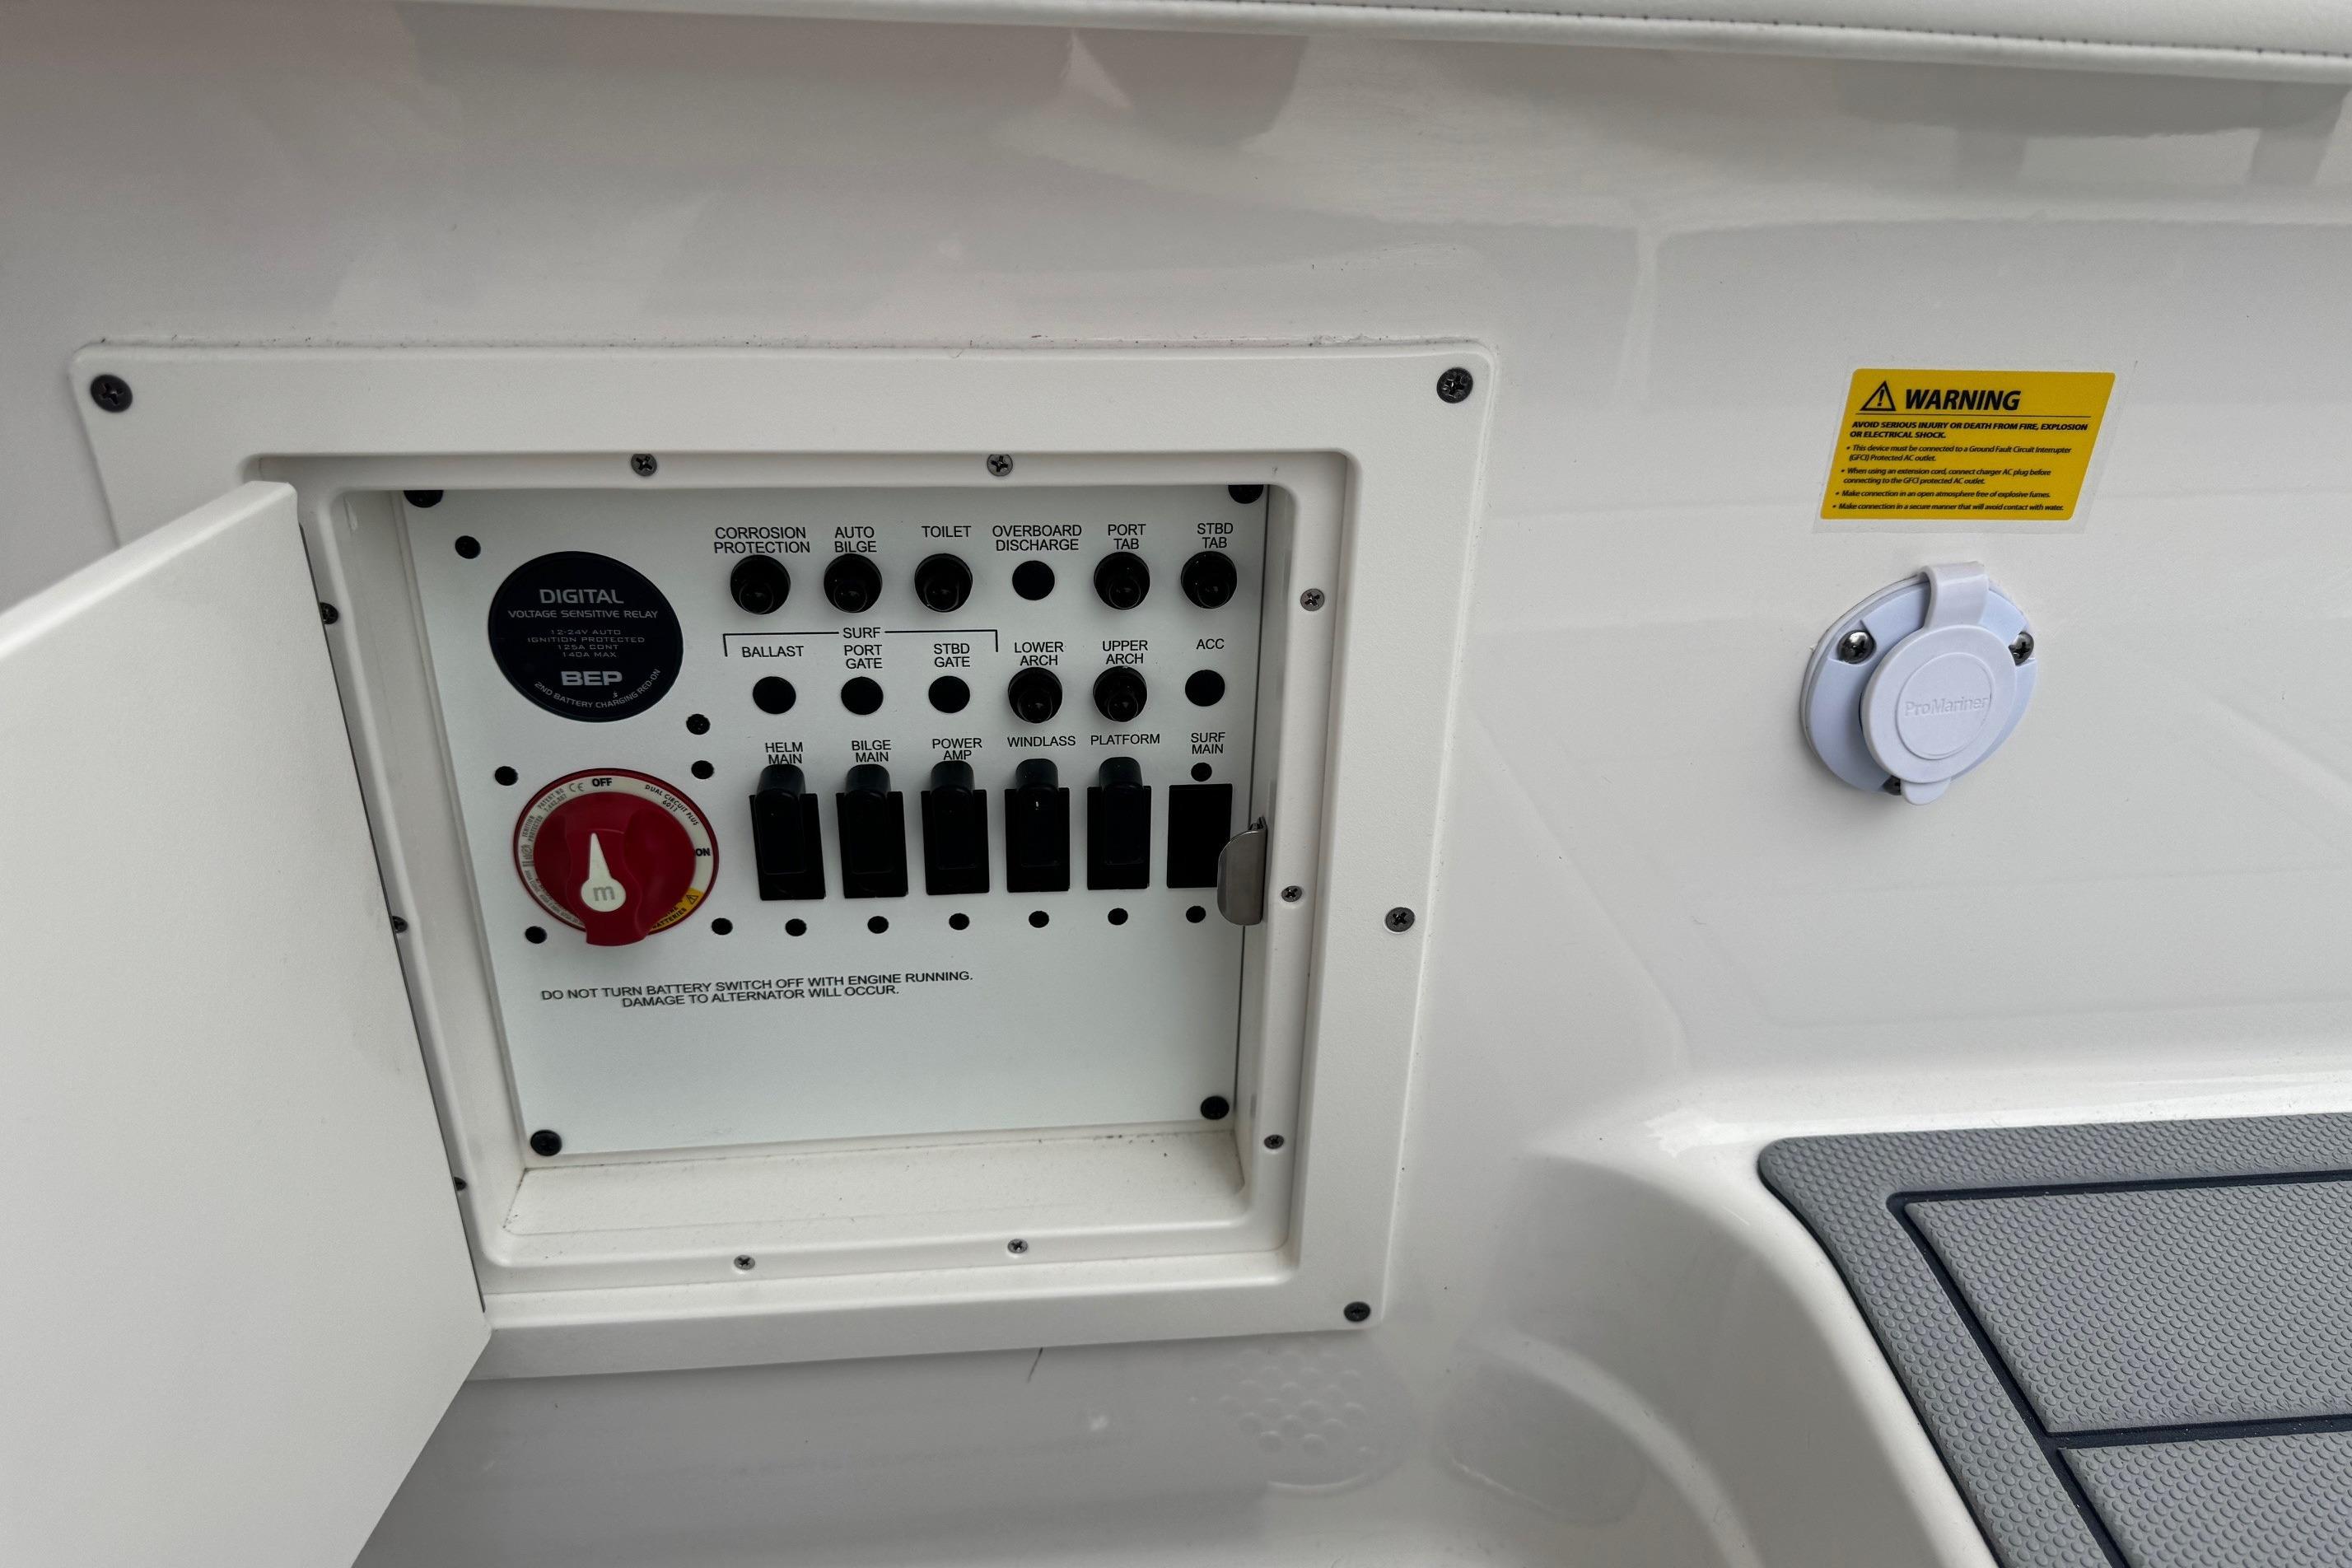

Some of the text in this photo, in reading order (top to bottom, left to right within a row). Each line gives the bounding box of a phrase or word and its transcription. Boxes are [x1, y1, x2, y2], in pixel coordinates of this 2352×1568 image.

[1905, 389, 2021, 411] WARNING
[715, 526, 806, 539] CORROSION
[835, 526, 875, 539] AUTO
[922, 525, 972, 538] TOILET
[992, 525, 1082, 537] OVERBOARD
[1108, 524, 1146, 536] PORT
[1197, 522, 1234, 534] STBD
[714, 541, 810, 553] PROTECTION
[835, 541, 877, 553] BILGE
[996, 539, 1079, 552] DISCHARGE
[1113, 539, 1139, 550] TAB
[1202, 537, 1227, 548] TAB
[539, 589, 624, 604] DIGITAL
[508, 610, 557, 618] VOLTAGE
[624, 610, 659, 618] RELAY
[843, 627, 881, 639] SURF
[844, 644, 882, 656] PORT
[933, 643, 970, 655] STBD
[1014, 642, 1064, 653] LOWER
[1102, 640, 1148, 651] UPPER
[1197, 638, 1225, 650] ACC
[742, 646, 804, 658] BALLAST
[846, 658, 883, 670] GATE
[934, 656, 971, 668] GATE
[1020, 655, 1058, 666] ARCH
[1105, 653, 1144, 665] ARCH
[561, 671, 623, 686] BEP
[534, 681, 553, 697] 2ND
[553, 693, 593, 708] BATTERY
[595, 692, 639, 708] CHARGING
[1904, 696, 1990, 716] ProMariner
[932, 737, 982, 749] POWER
[1007, 735, 1076, 748] WINDLASS
[1090, 734, 1160, 745] PLATFORM
[1191, 732, 1225, 744] SURF
[765, 742, 804, 754] HELM
[852, 740, 892, 751] BILGE
[1192, 744, 1224, 754] MAIN
[768, 754, 803, 765] MAIN
[856, 752, 889, 763] MAIN
[943, 749, 972, 761] AMP
[592, 777, 612, 787] OFF
[537, 791, 556, 810] PATENT
[645, 784, 699, 826] DUAL CIRCUIT PLUS
[521, 815, 535, 838] IGNITION
[528, 815, 544, 842] PROTECTED
[695, 848, 711, 856] ON
[593, 885, 616, 902] m
[541, 971, 973, 1001] DO NOT TURN BATTERY SWITCH OFF WITH ENGINE RUNNING.
[622, 985, 899, 1008] DAMAGE TO ALTERNATOR WILL OCCUR.
